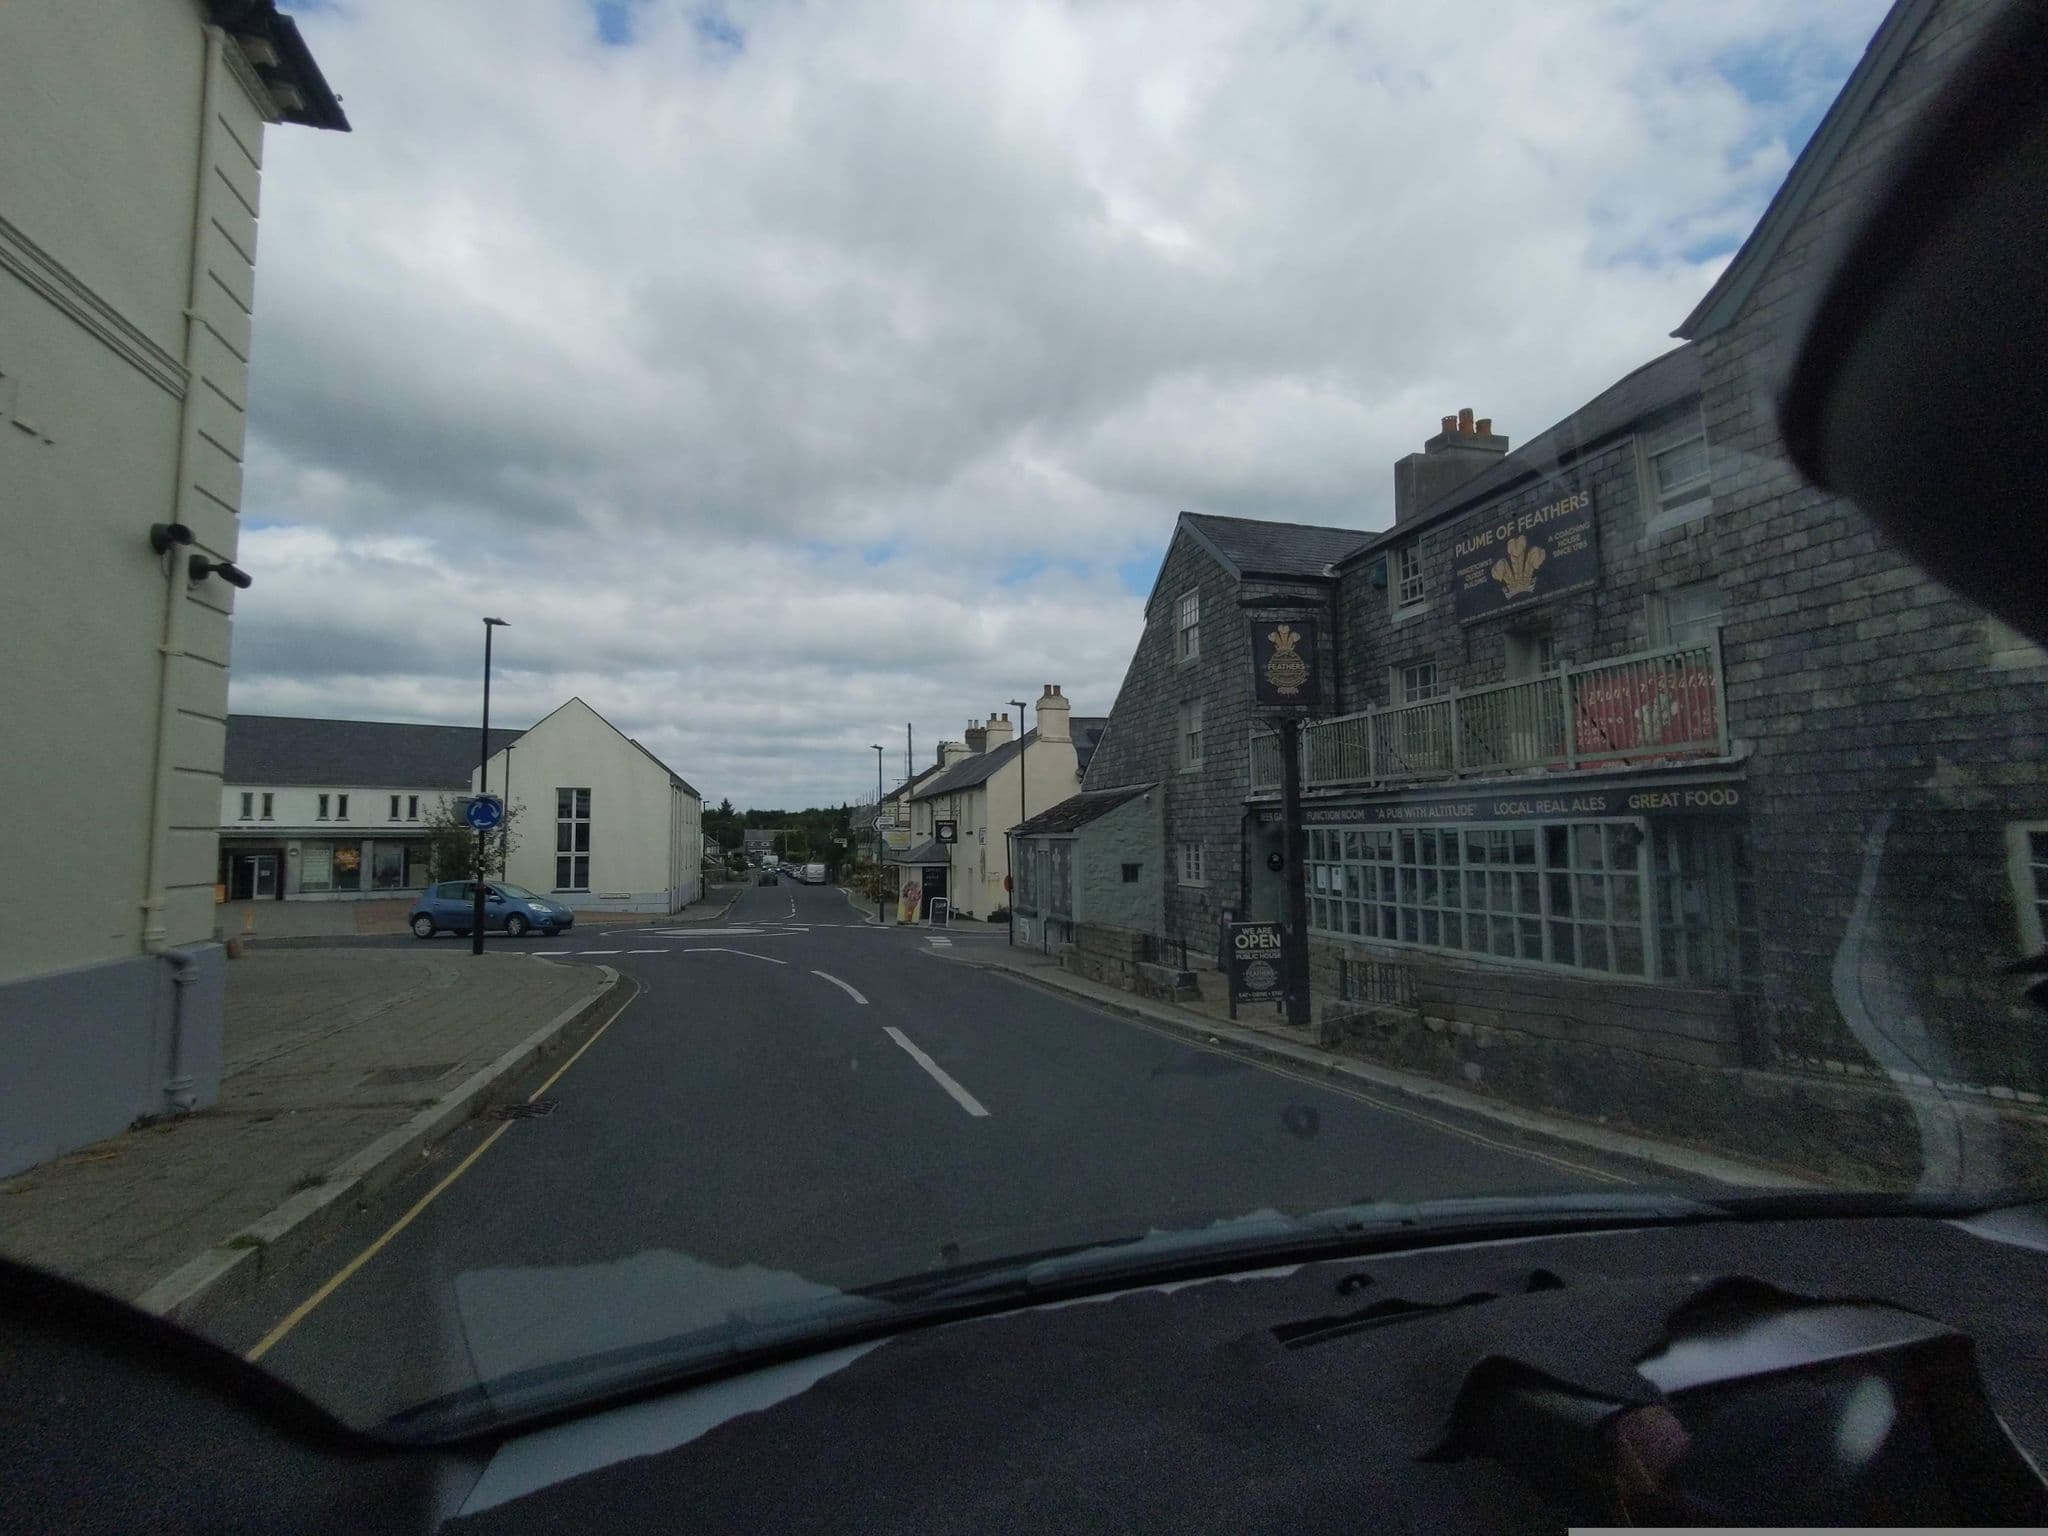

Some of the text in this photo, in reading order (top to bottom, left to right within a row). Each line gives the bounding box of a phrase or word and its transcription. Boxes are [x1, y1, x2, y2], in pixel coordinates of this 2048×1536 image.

[1455, 490, 1590, 558] PLUME OF FEATHERS
[1493, 796, 1607, 816] LOCAL REAL ALES
[1628, 789, 1739, 810] GREAT FOOD
[1306, 809, 1365, 822] FUNCTION ROOM
[1386, 808, 1403, 819] PUB
[1403, 806, 1427, 819] WITH
[1256, 927, 1273, 935] ARE
[1234, 934, 1281, 949] OPEN
